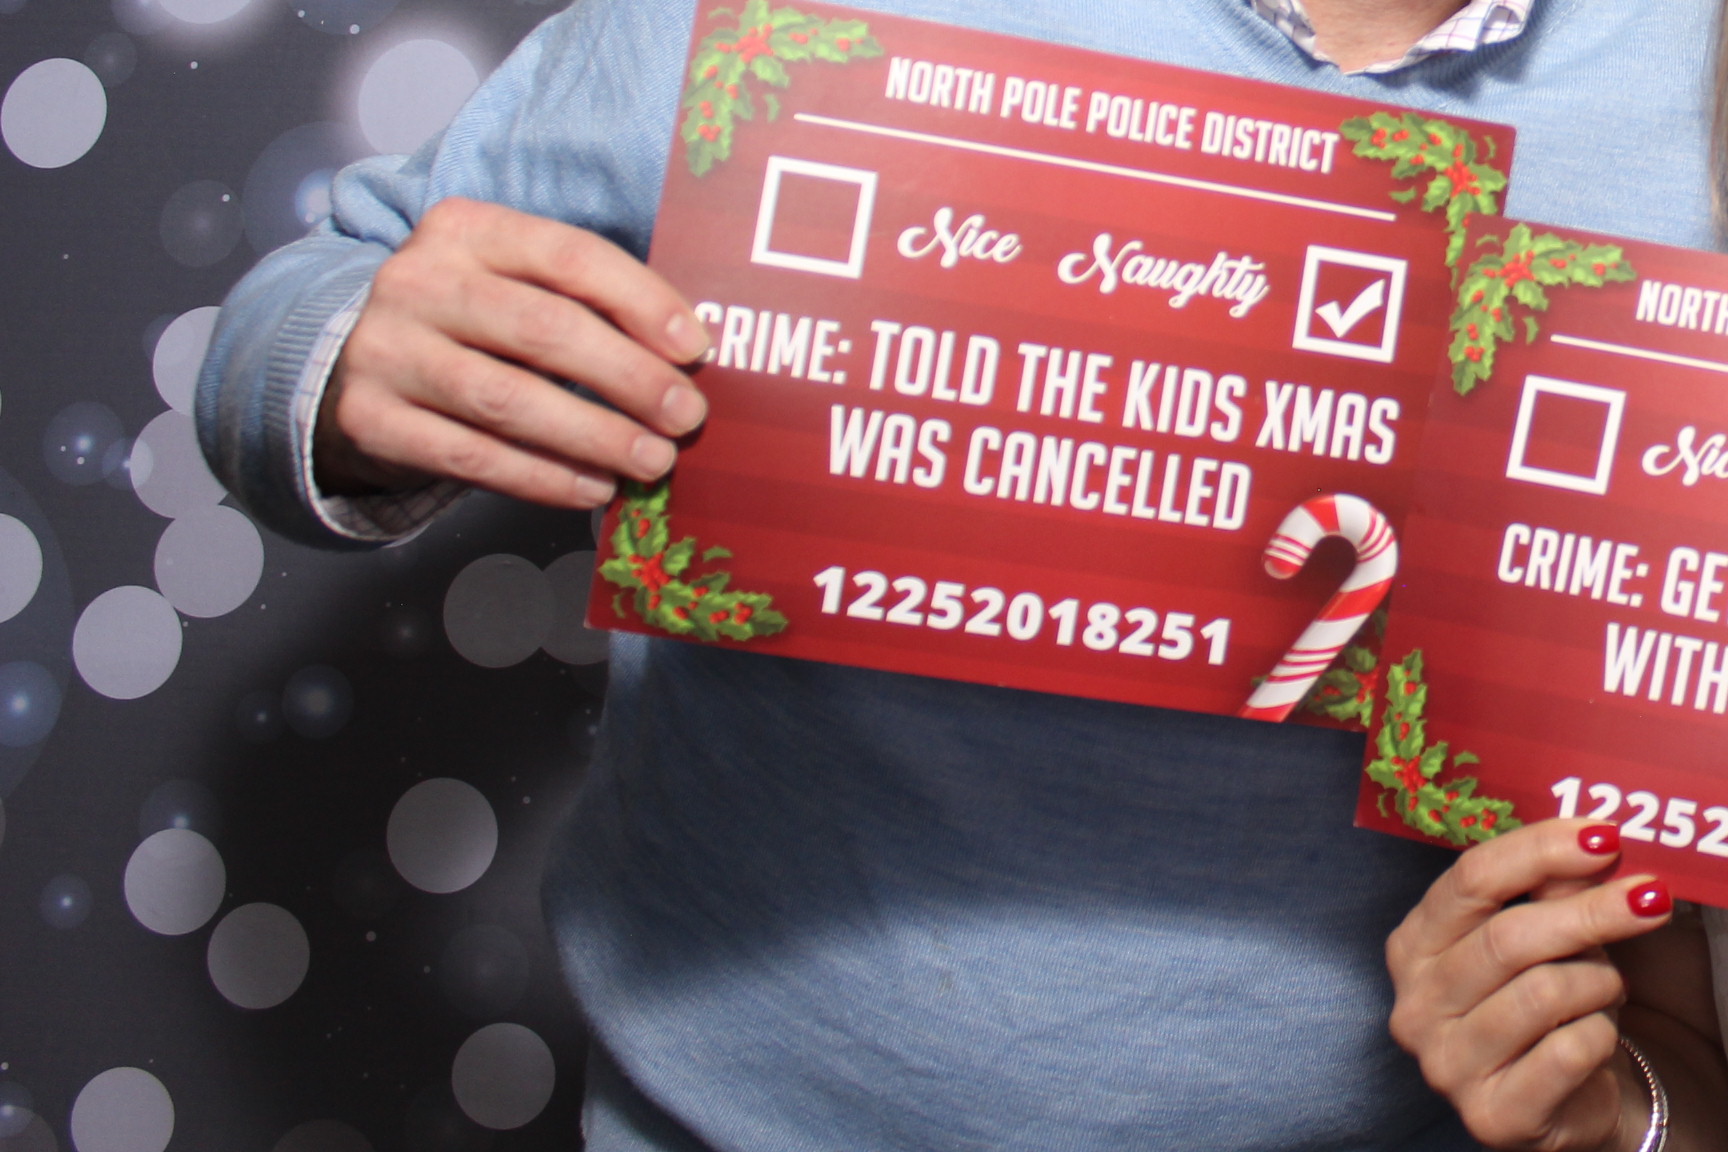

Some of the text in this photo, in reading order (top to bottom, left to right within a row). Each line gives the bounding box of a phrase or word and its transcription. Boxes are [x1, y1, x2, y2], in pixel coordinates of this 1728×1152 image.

[885, 56, 1340, 174] NORTH POLE POLICE DISTRICT
[896, 206, 1270, 318] Nice Naughty
[868, 319, 1000, 406] TOLD
[1015, 342, 1113, 424] THE
[1122, 360, 1247, 442] KIDS
[1254, 380, 1400, 465] XMAS
[829, 404, 1252, 530] WAS CANCELLED
[812, 566, 1231, 666] 12252018251
[1497, 523, 1649, 608] CRIME:
